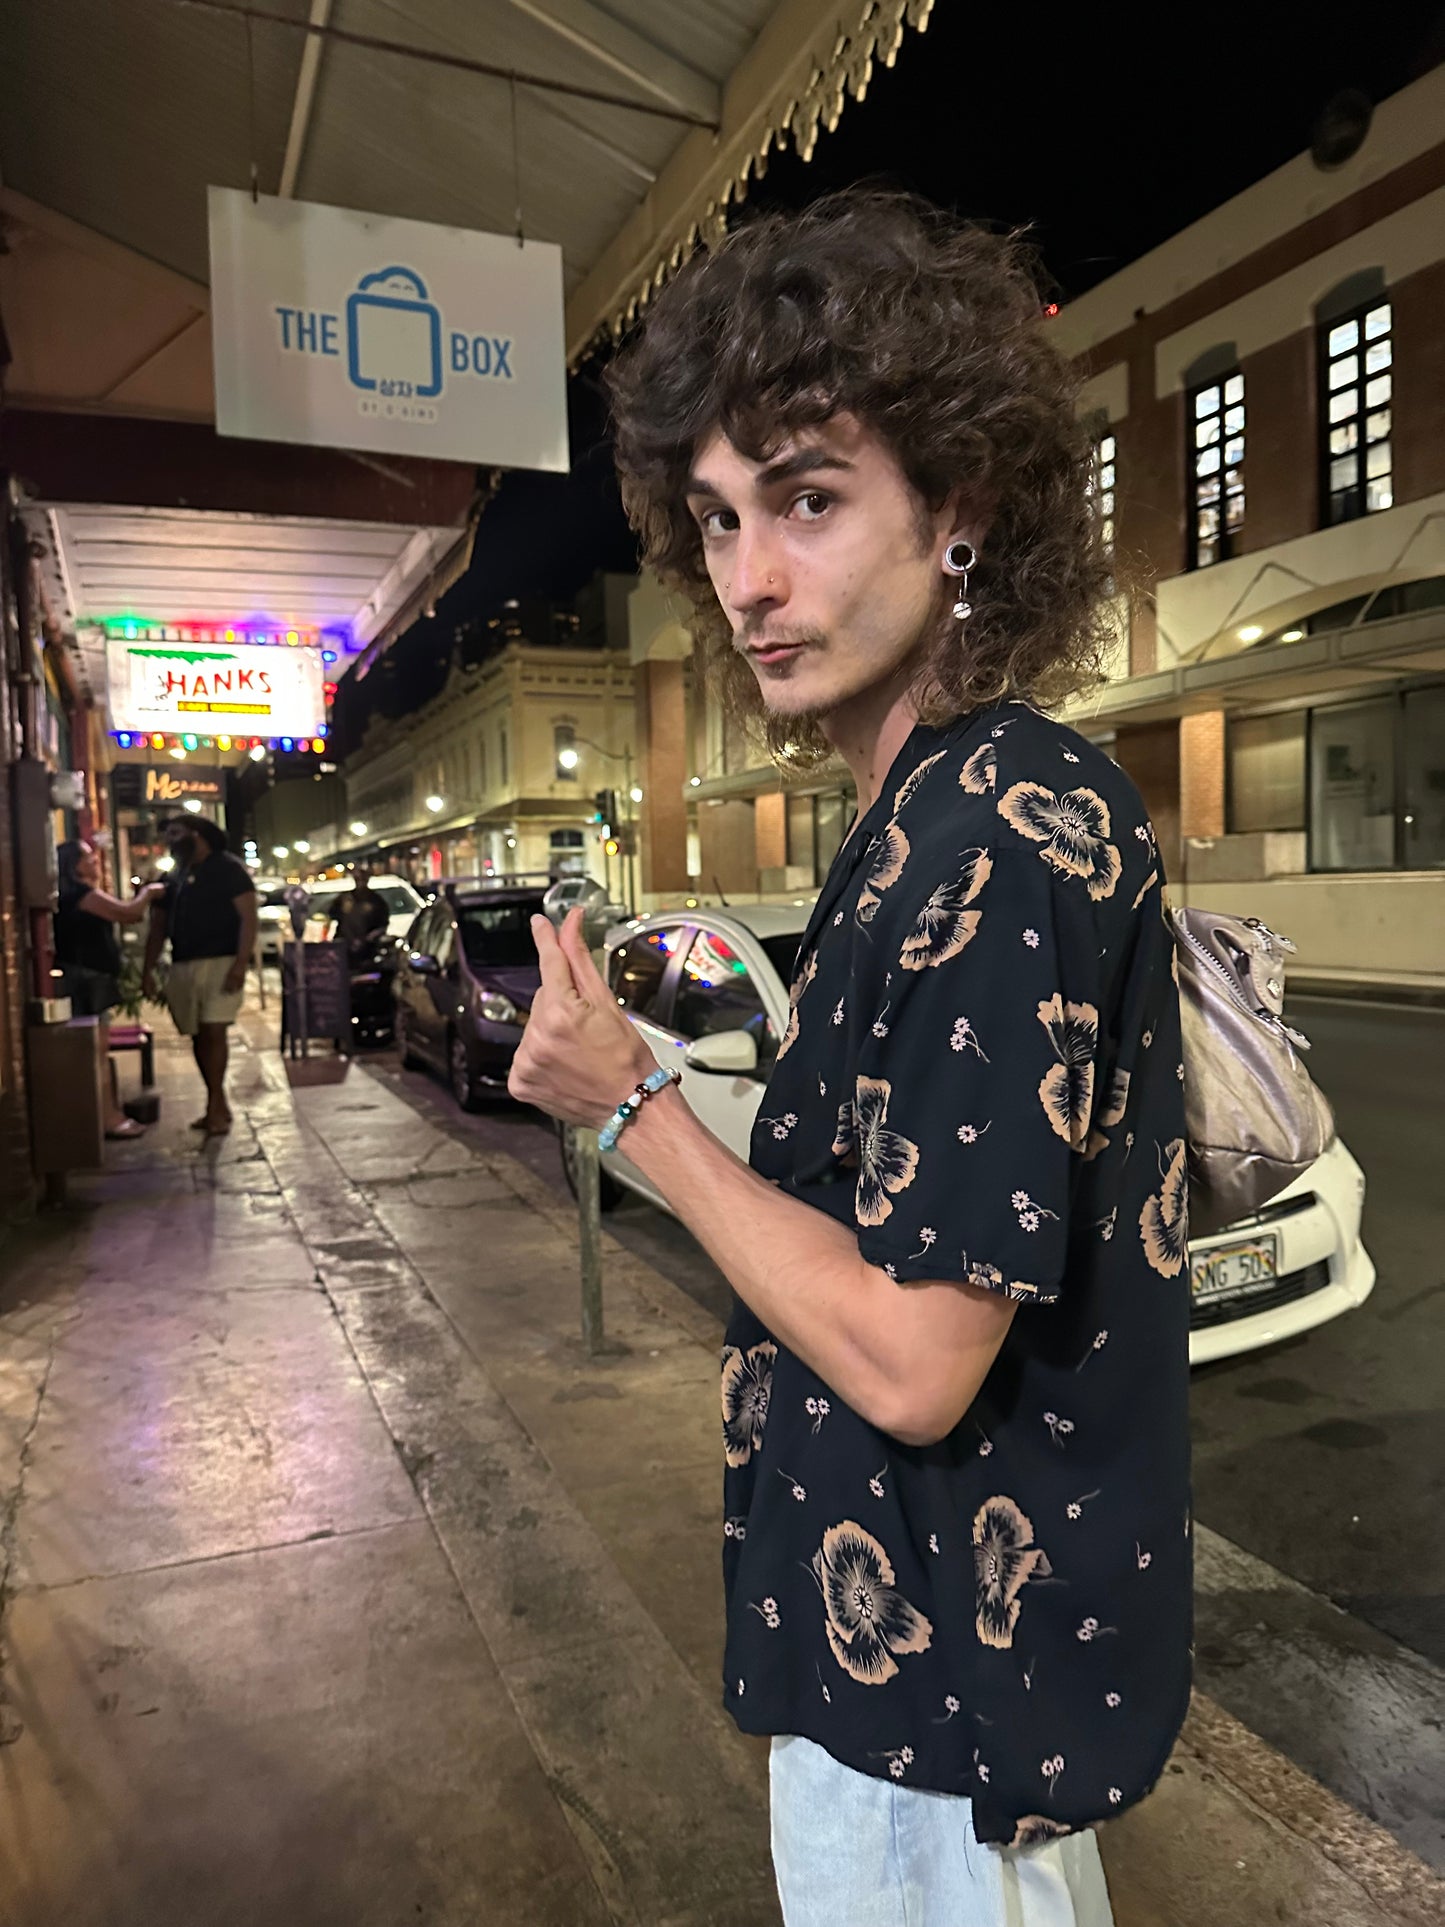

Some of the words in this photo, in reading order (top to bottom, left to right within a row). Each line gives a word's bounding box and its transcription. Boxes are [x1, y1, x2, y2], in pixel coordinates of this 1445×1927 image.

[275, 307, 339, 356] THE
[450, 332, 513, 378] BOX
[1192, 1259, 1228, 1291] SNG
